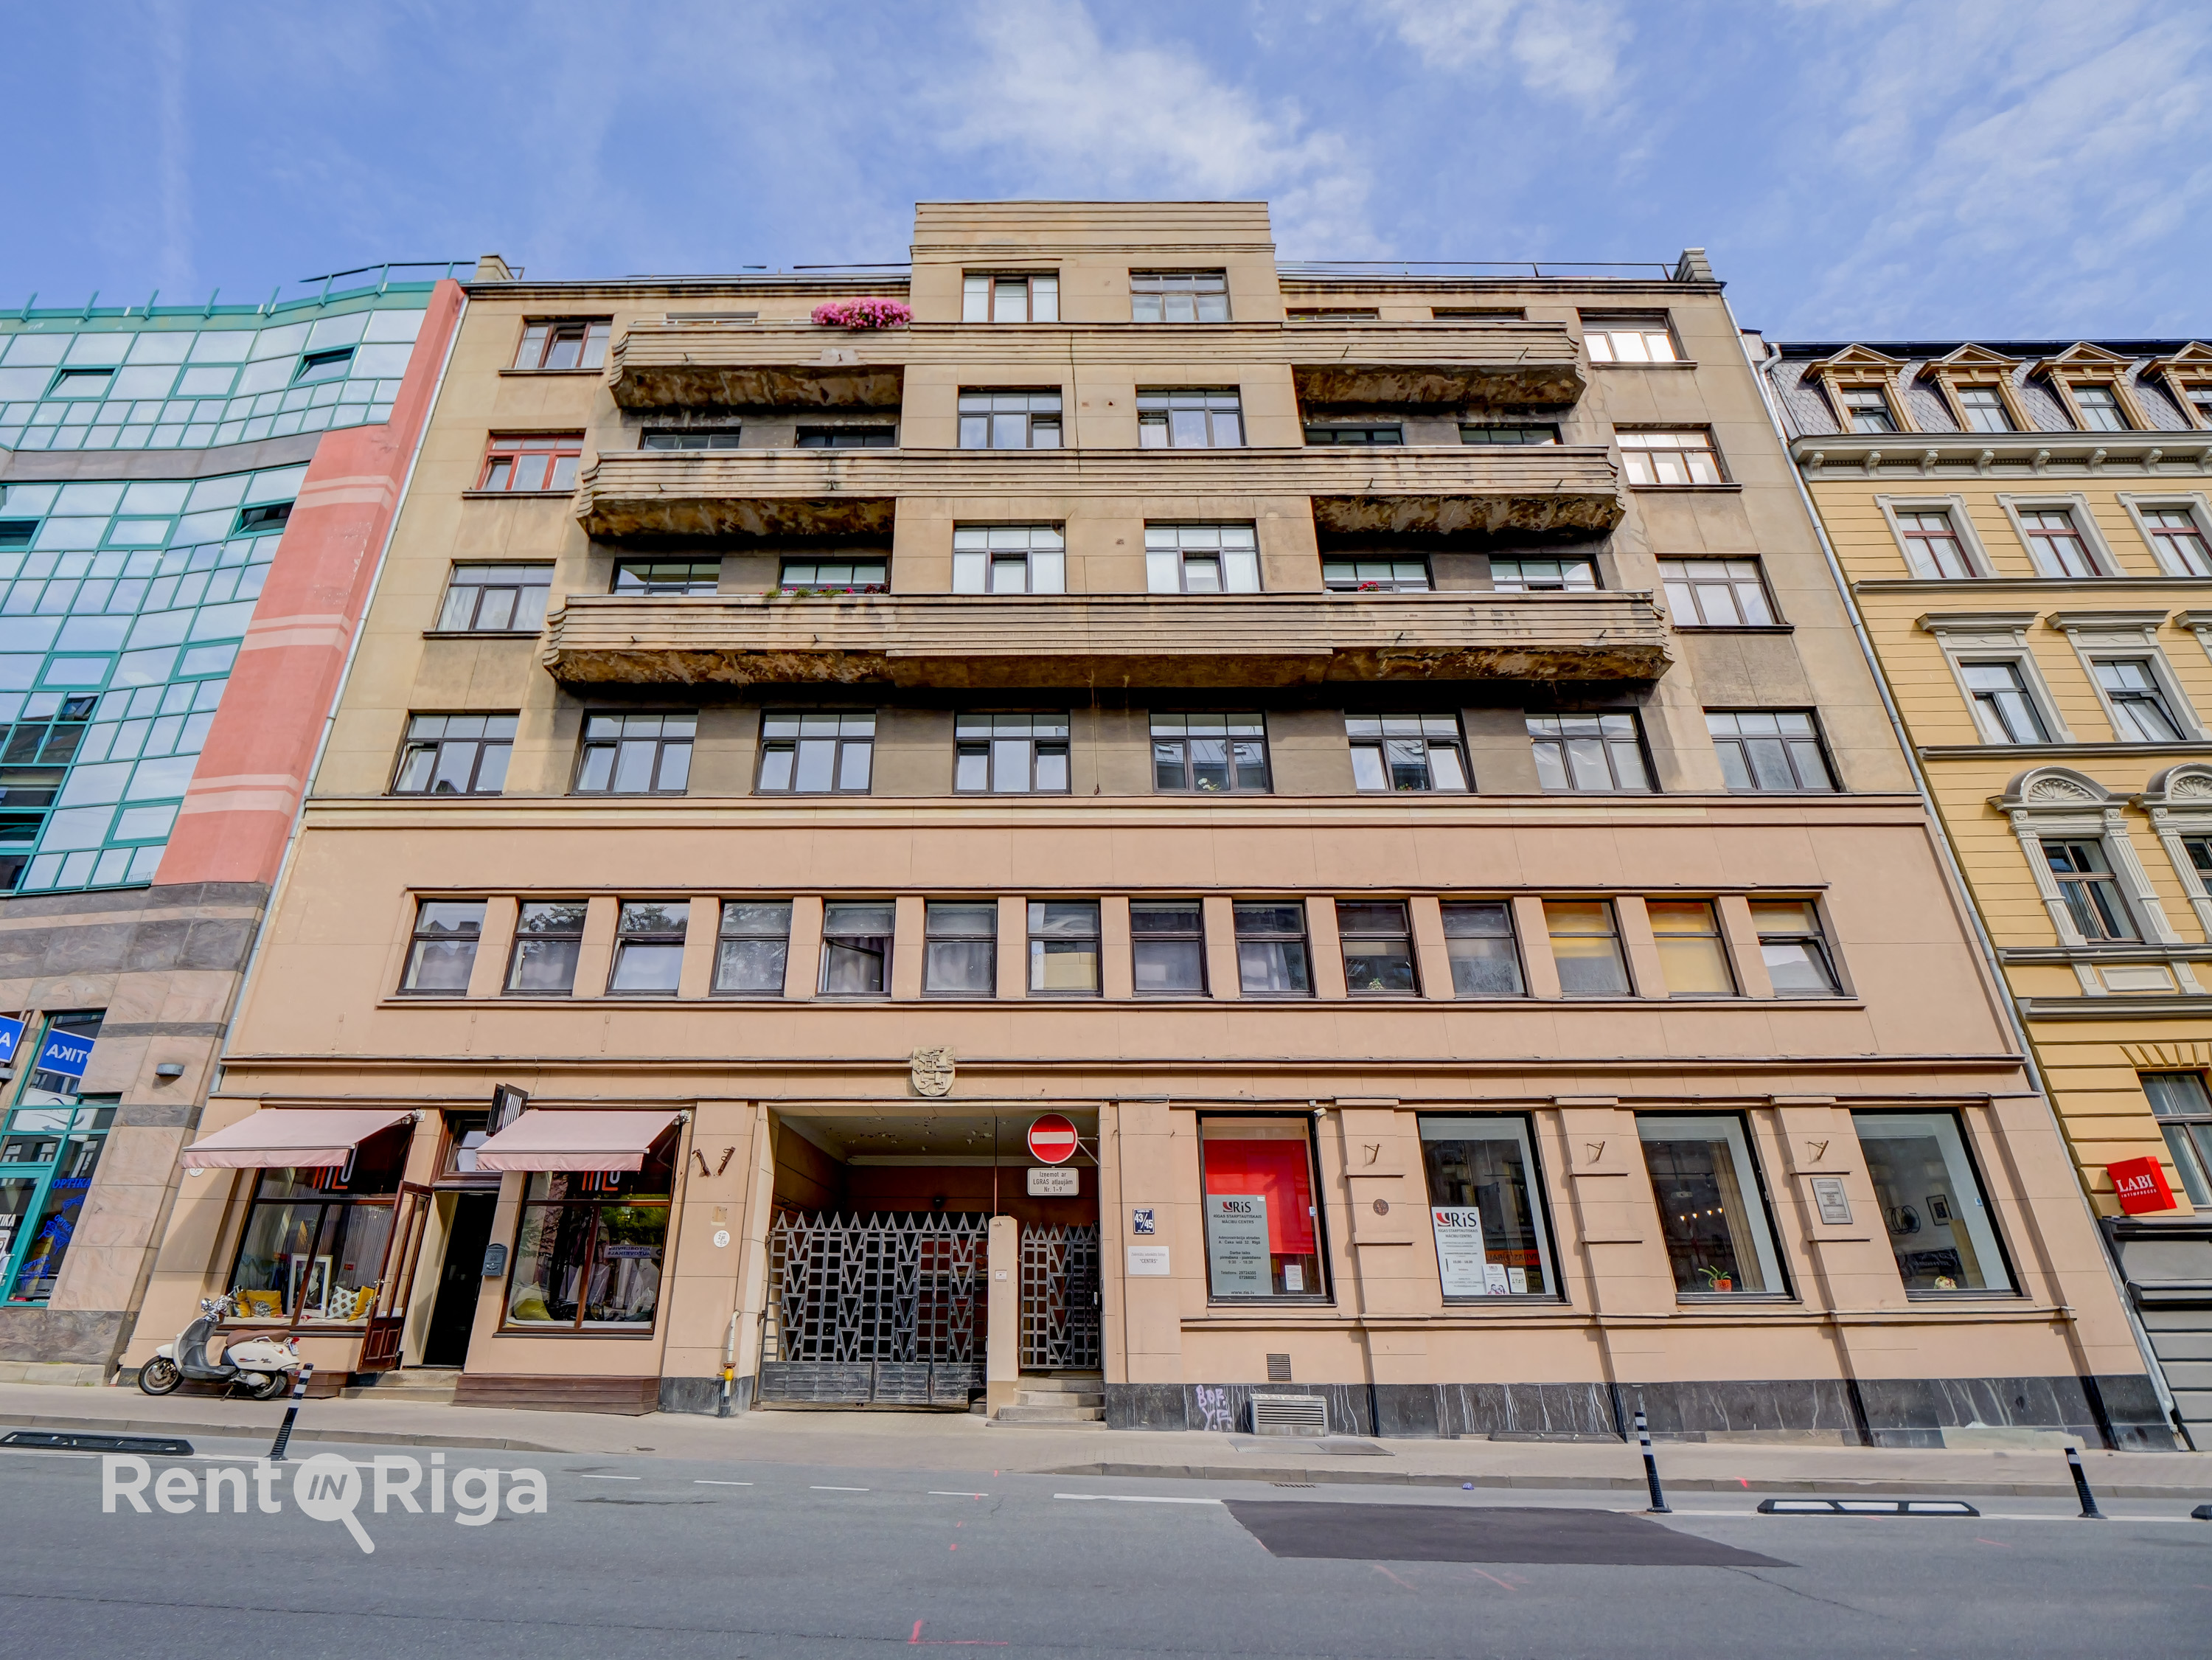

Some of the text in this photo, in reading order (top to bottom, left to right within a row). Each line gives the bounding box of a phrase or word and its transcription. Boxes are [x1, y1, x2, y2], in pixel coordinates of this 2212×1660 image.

[52, 1178, 91, 1189] OPTIKA
[2116, 1174, 2154, 1192] LABI
[1233, 1201, 1251, 1213] RiS
[54, 1214, 73, 1233] OPTIKA
[1450, 1212, 1476, 1227] RiS
